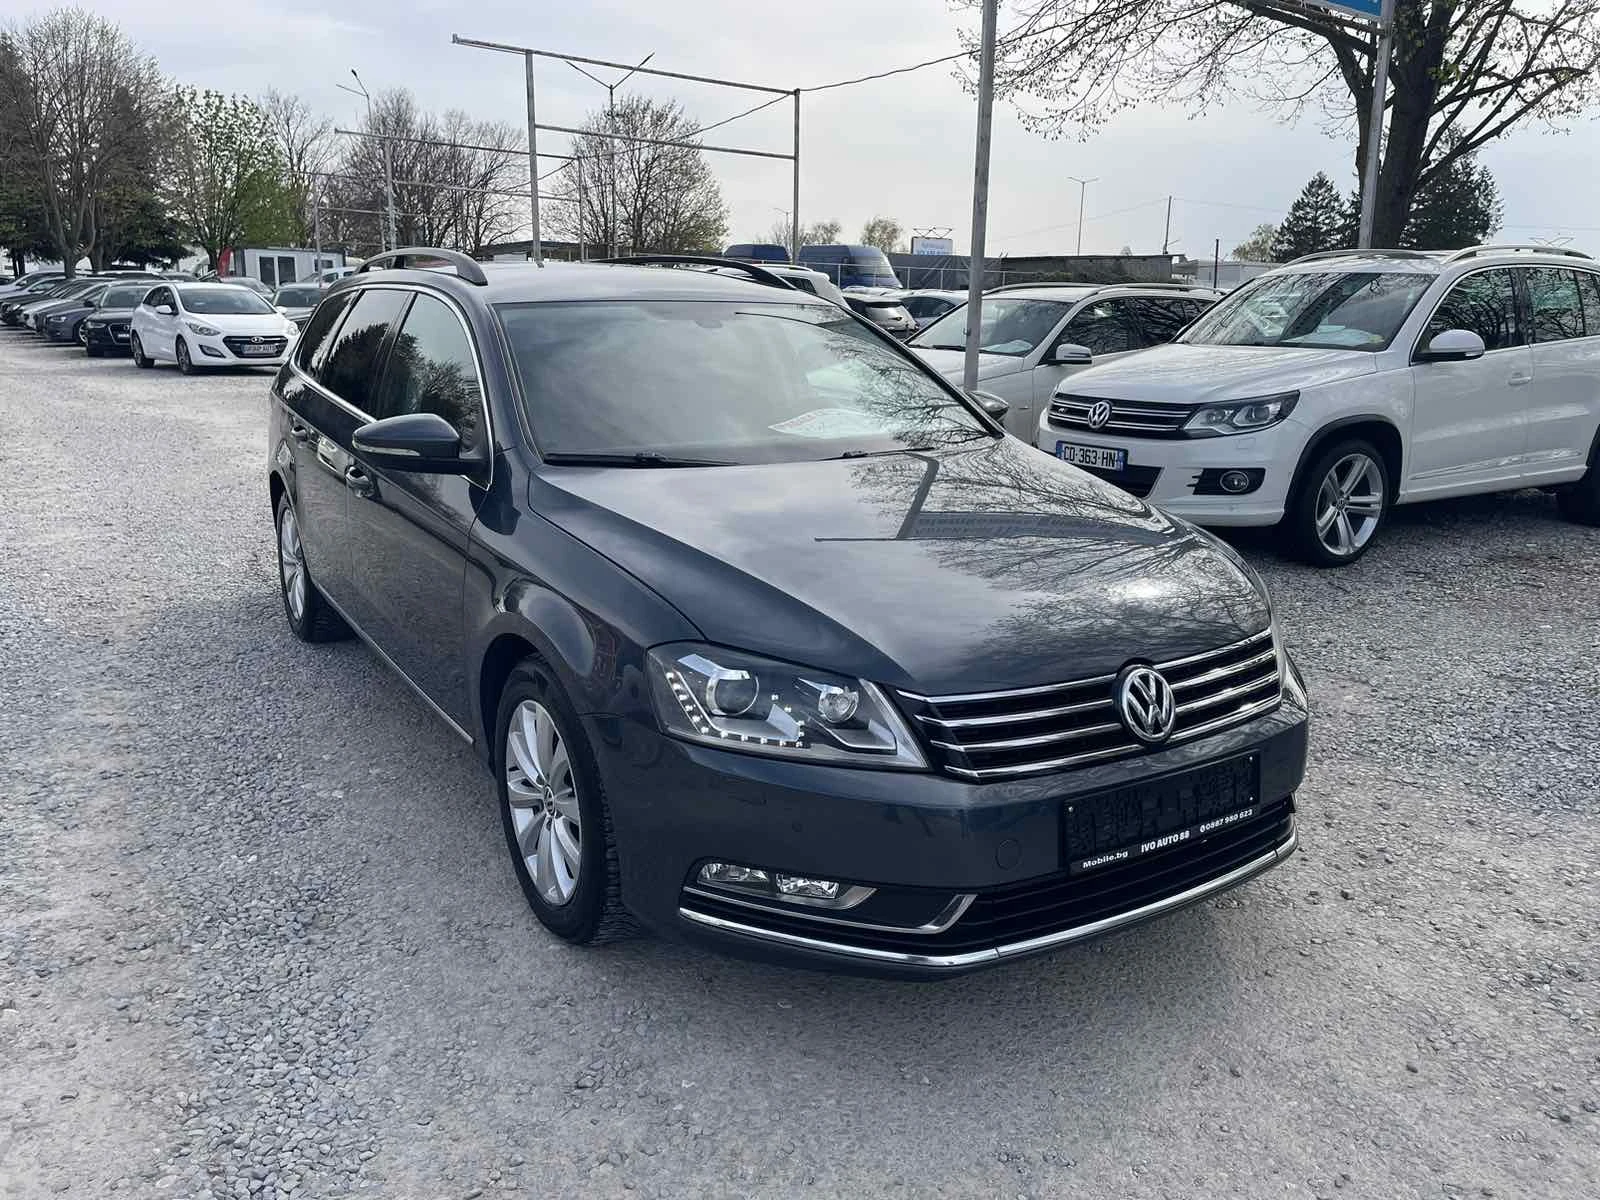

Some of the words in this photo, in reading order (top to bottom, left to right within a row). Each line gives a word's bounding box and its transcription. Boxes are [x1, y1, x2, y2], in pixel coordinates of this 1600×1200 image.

[1082, 851, 1128, 869] Mobile.bg
[1140, 841, 1156, 853] IVO
[1156, 833, 1179, 848] AUTO
[1179, 830, 1190, 841] 88
